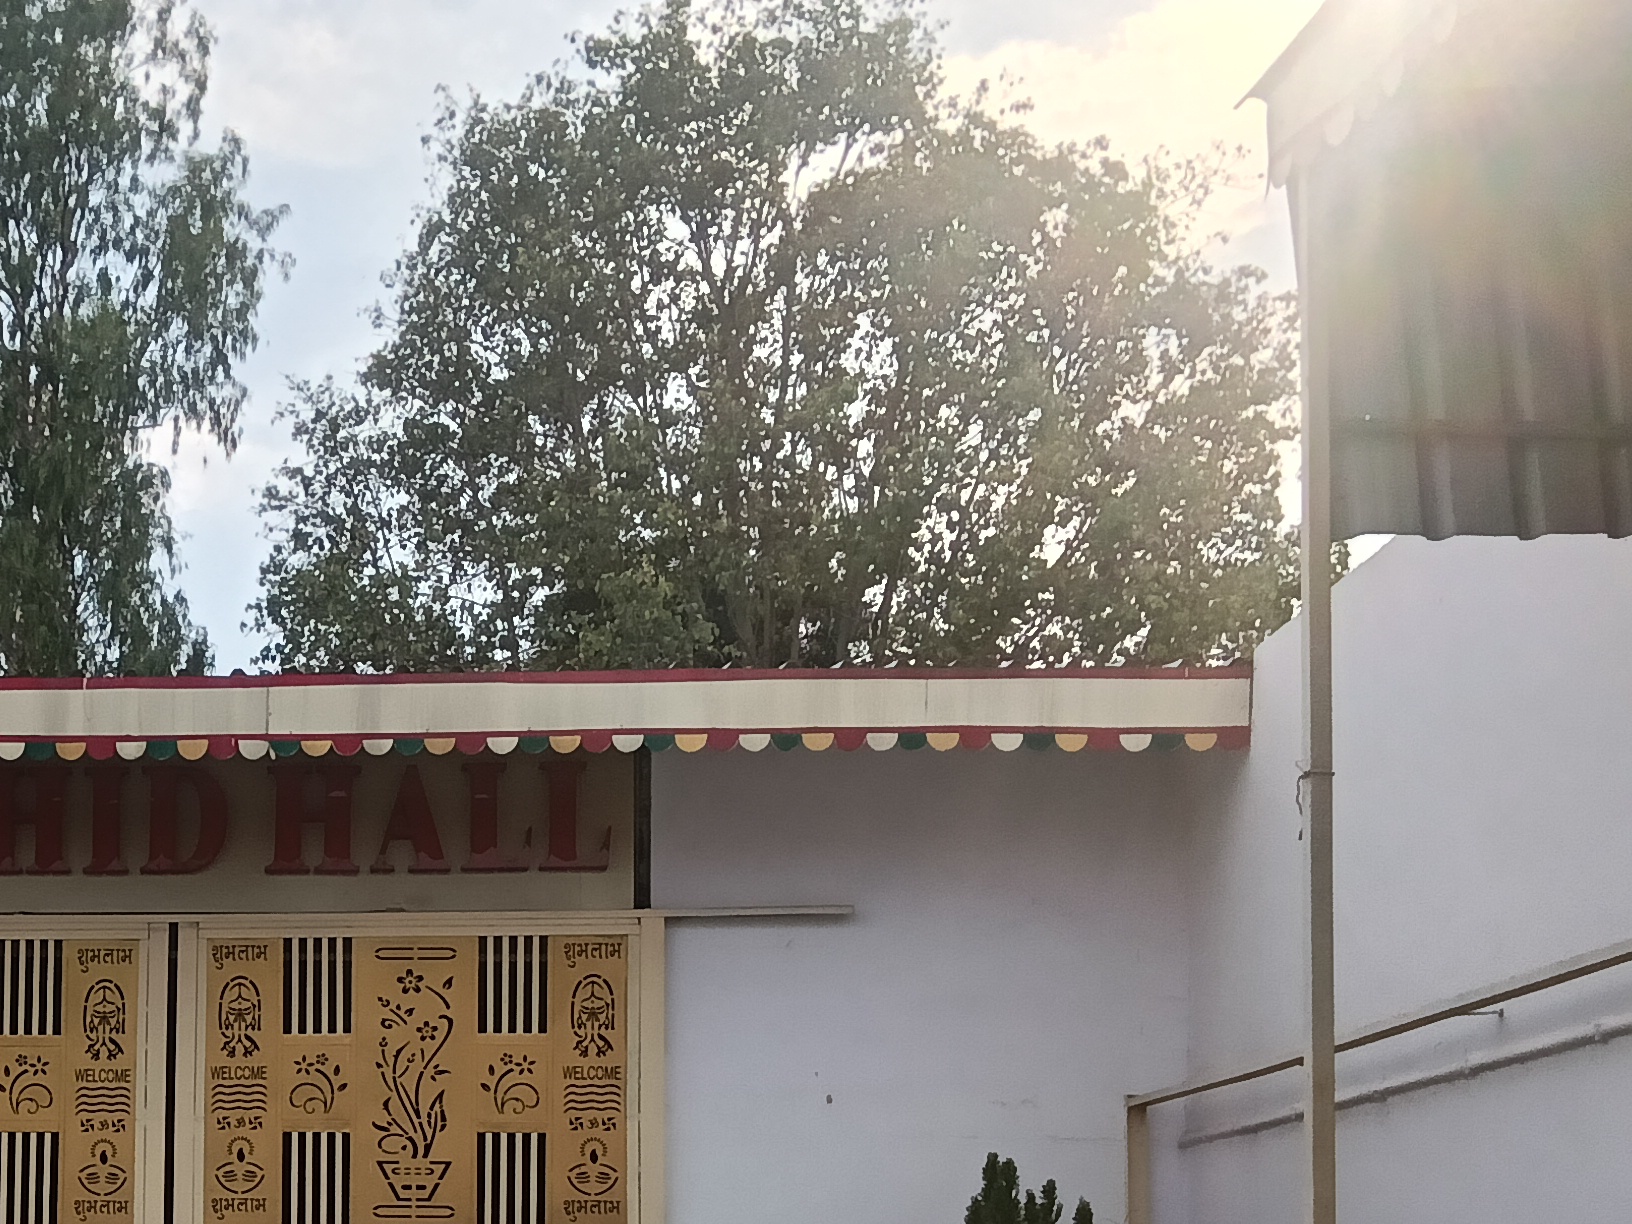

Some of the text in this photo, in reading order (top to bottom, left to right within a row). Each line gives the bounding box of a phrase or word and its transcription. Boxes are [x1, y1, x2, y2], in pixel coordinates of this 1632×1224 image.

[264, 761, 612, 876] HALL
[74, 1068, 131, 1084] WELCOME
[210, 1065, 268, 1081] WELCOME
[562, 1065, 622, 1081] WELCOME
